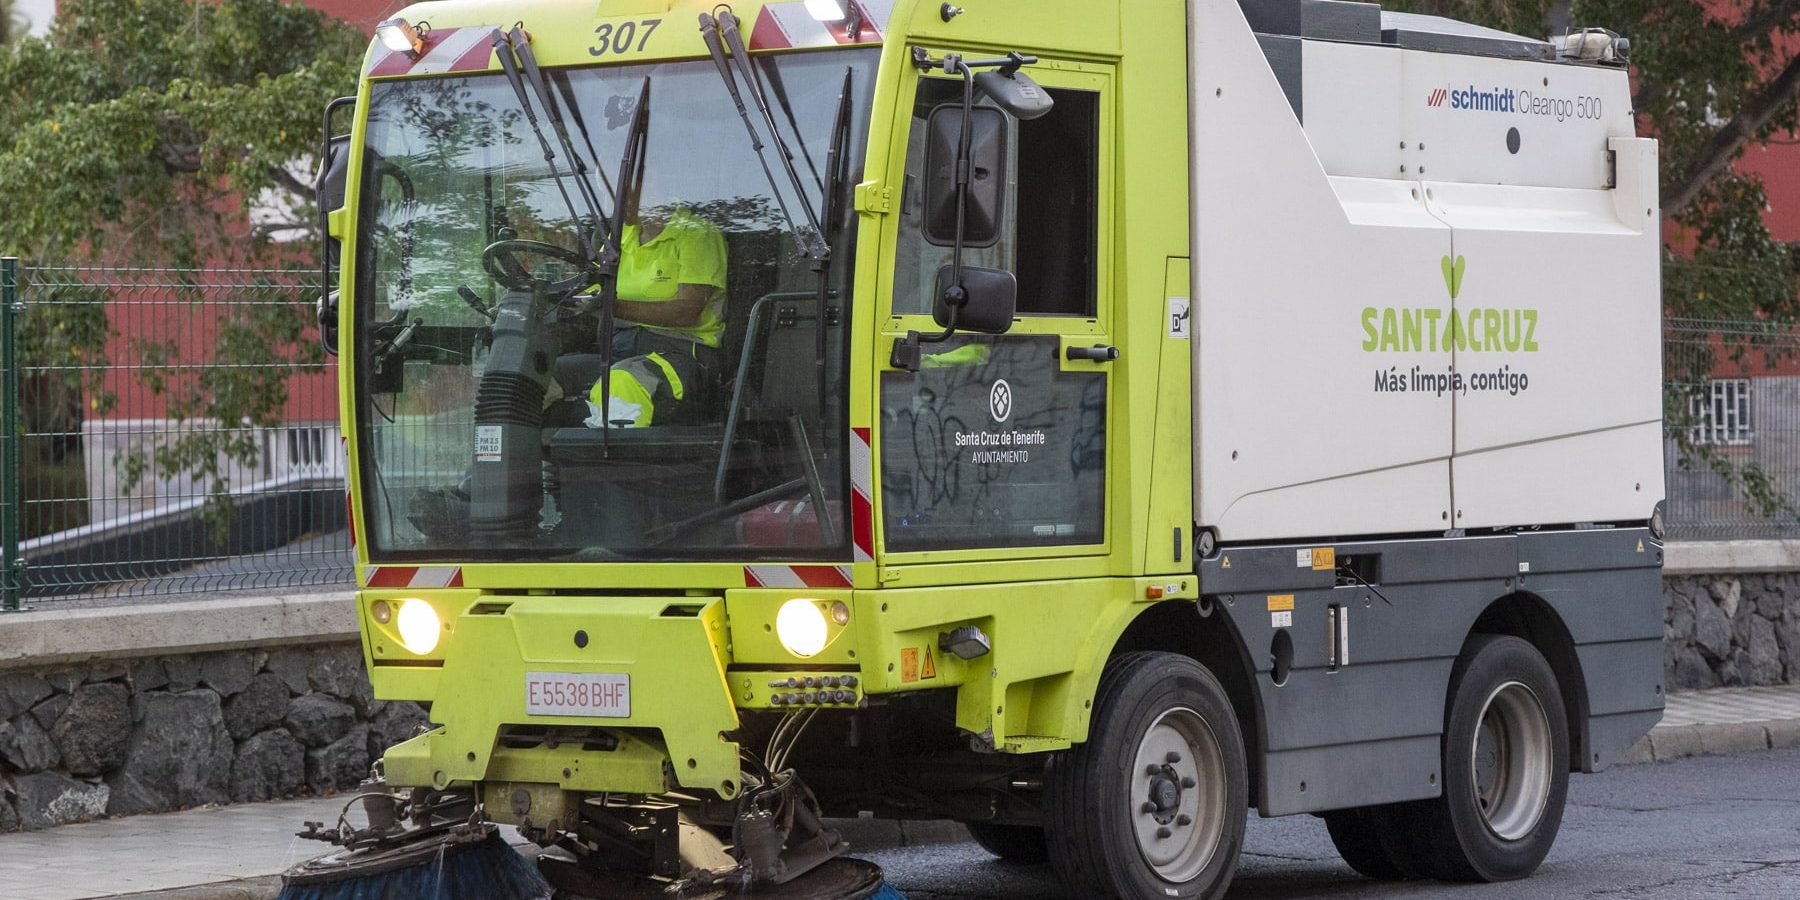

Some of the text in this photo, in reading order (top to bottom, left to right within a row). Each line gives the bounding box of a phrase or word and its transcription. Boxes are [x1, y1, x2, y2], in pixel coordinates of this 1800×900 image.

[589, 19, 662, 57] 307
[1451, 85, 1602, 122] schmidt Cleango 500
[1374, 365, 1529, 397] Más limpia, contigo
[955, 430, 1045, 446] Santa Cruz de Tenerife
[972, 450, 1029, 464] AYUNTAMIENTO
